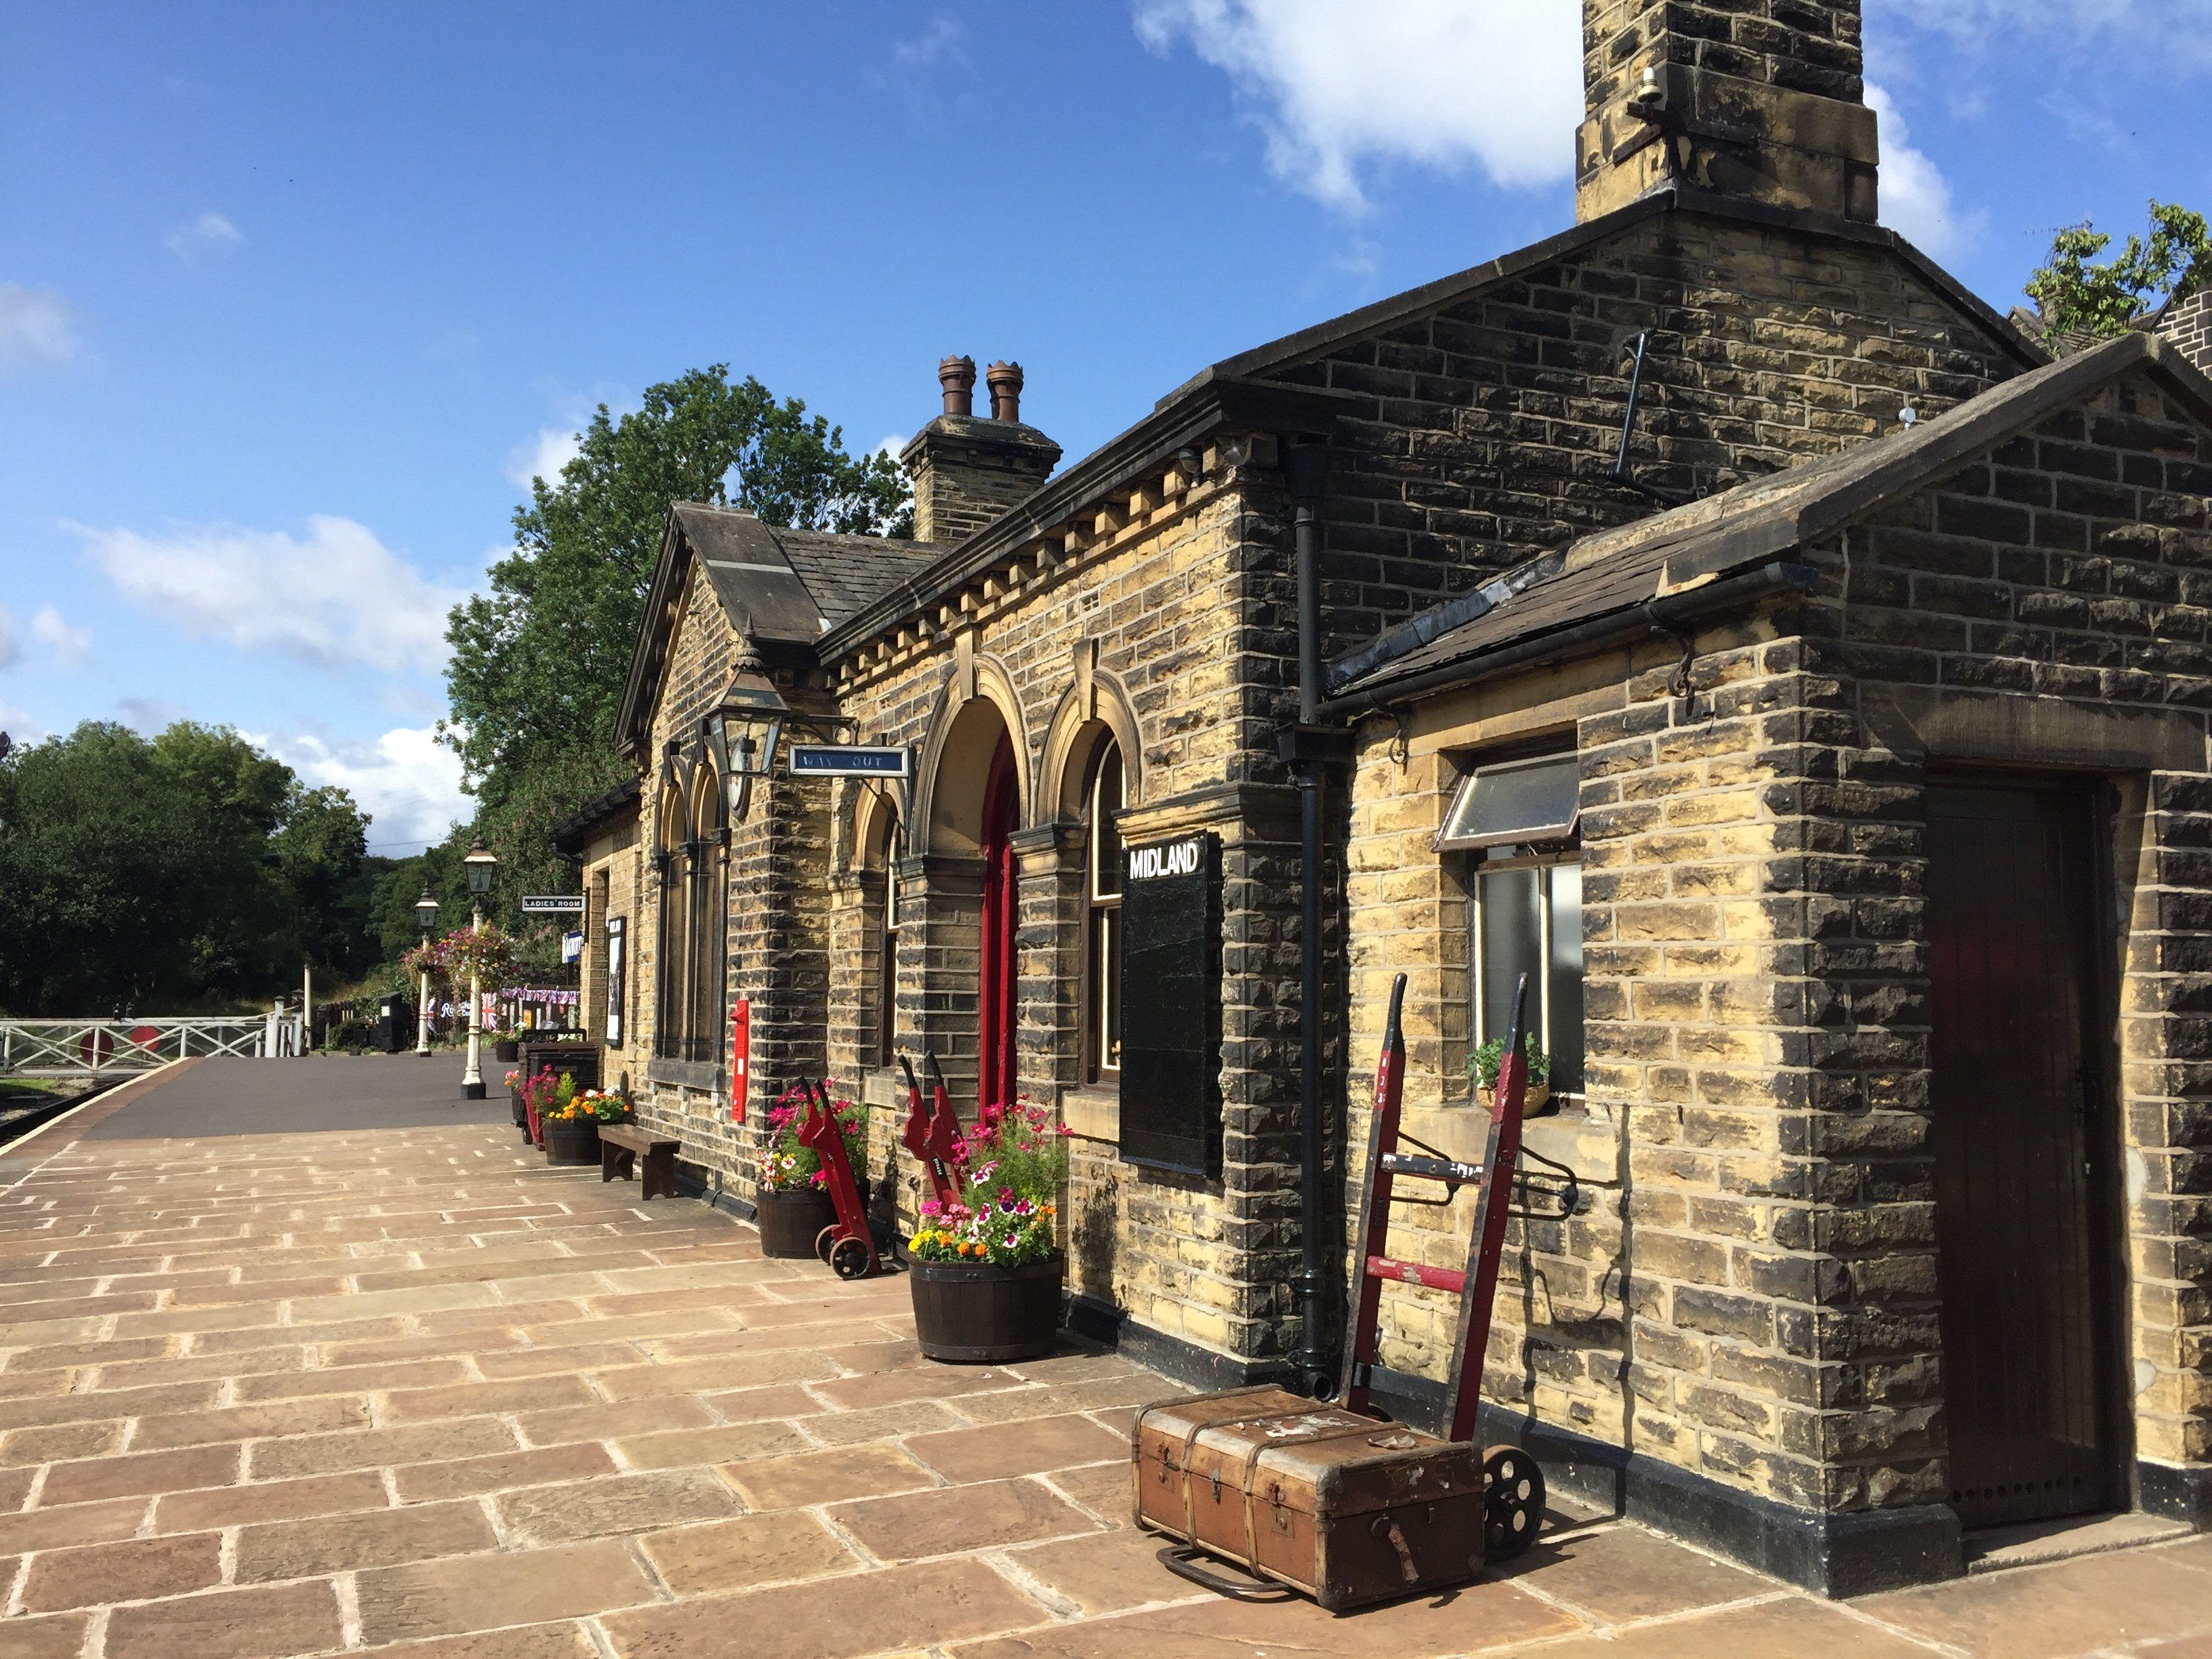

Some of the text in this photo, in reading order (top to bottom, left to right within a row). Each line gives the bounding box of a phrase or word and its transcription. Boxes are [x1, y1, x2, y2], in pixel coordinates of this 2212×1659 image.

[804, 756, 882, 766] WAY OUT
[1130, 842, 1197, 880] MIDLAND
